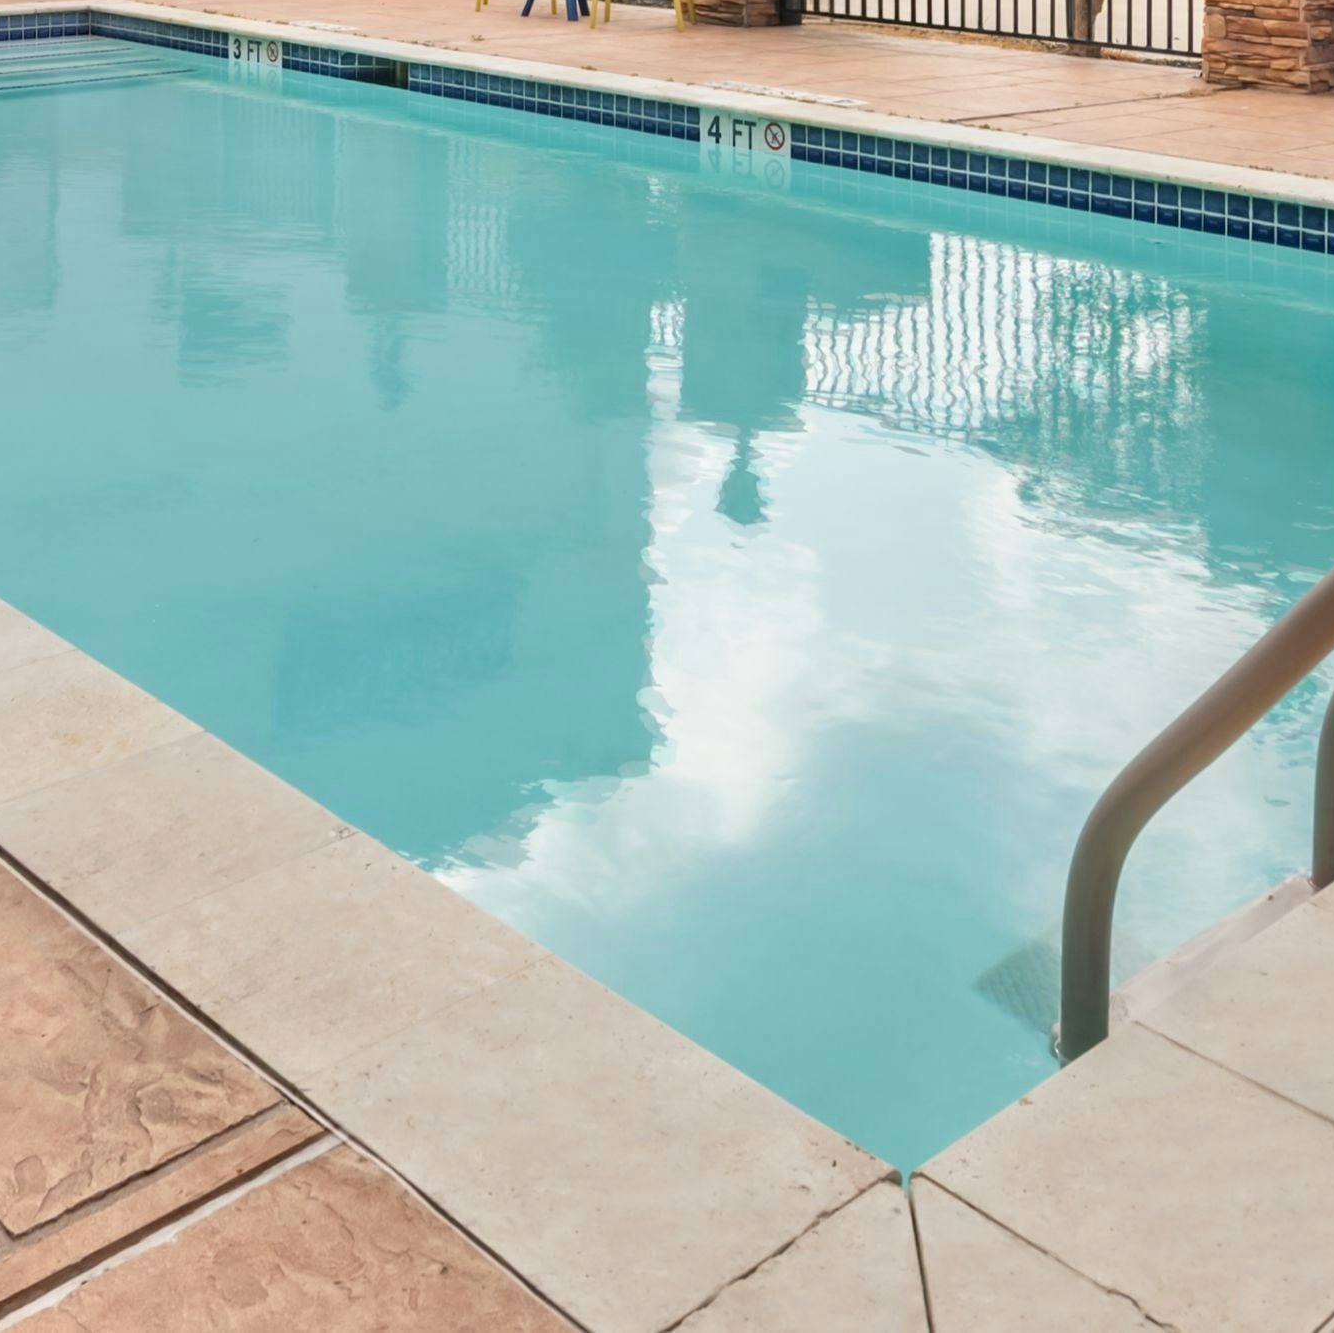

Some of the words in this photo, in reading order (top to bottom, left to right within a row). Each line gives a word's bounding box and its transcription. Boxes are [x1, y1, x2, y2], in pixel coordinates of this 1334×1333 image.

[233, 38, 242, 60] 3
[247, 40, 262, 63] FT
[707, 115, 722, 144] 4
[732, 119, 757, 150] FT
